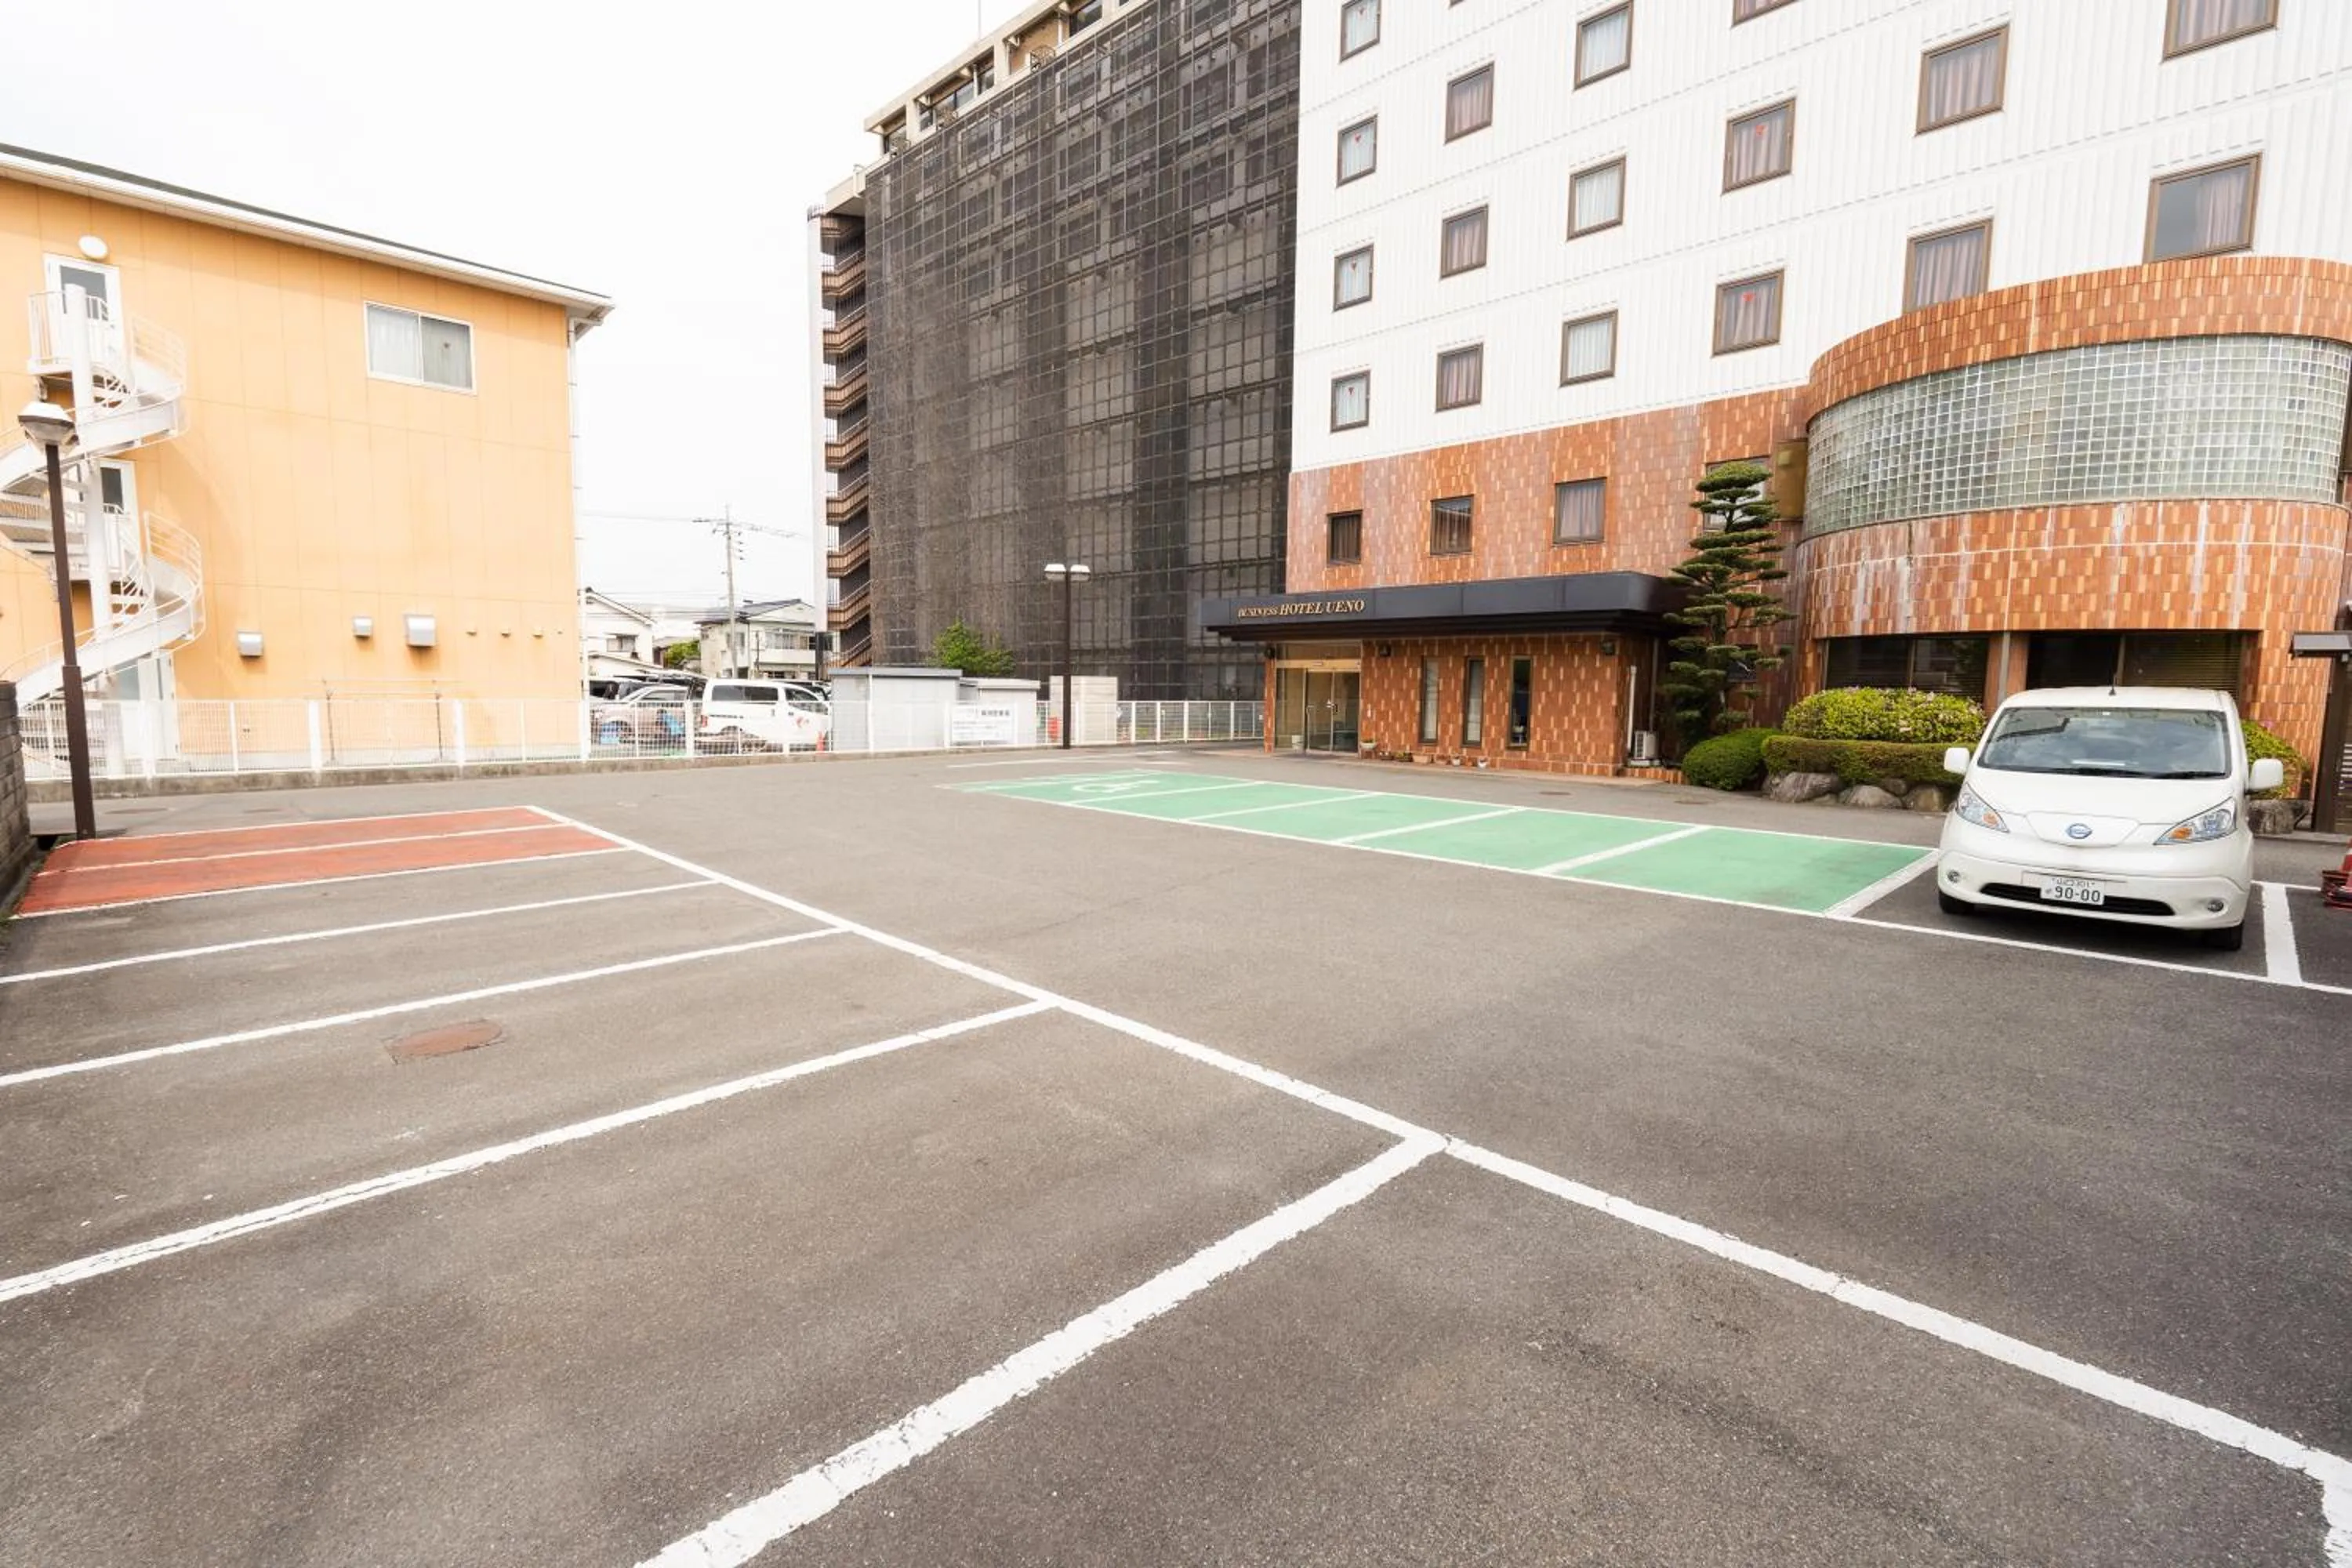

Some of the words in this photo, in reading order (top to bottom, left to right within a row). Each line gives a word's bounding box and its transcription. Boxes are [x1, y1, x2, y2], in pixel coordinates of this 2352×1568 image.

[1279, 602, 1323, 615] HOTEL
[1326, 599, 1365, 614] UENO
[2054, 886, 2100, 902] 90-00
